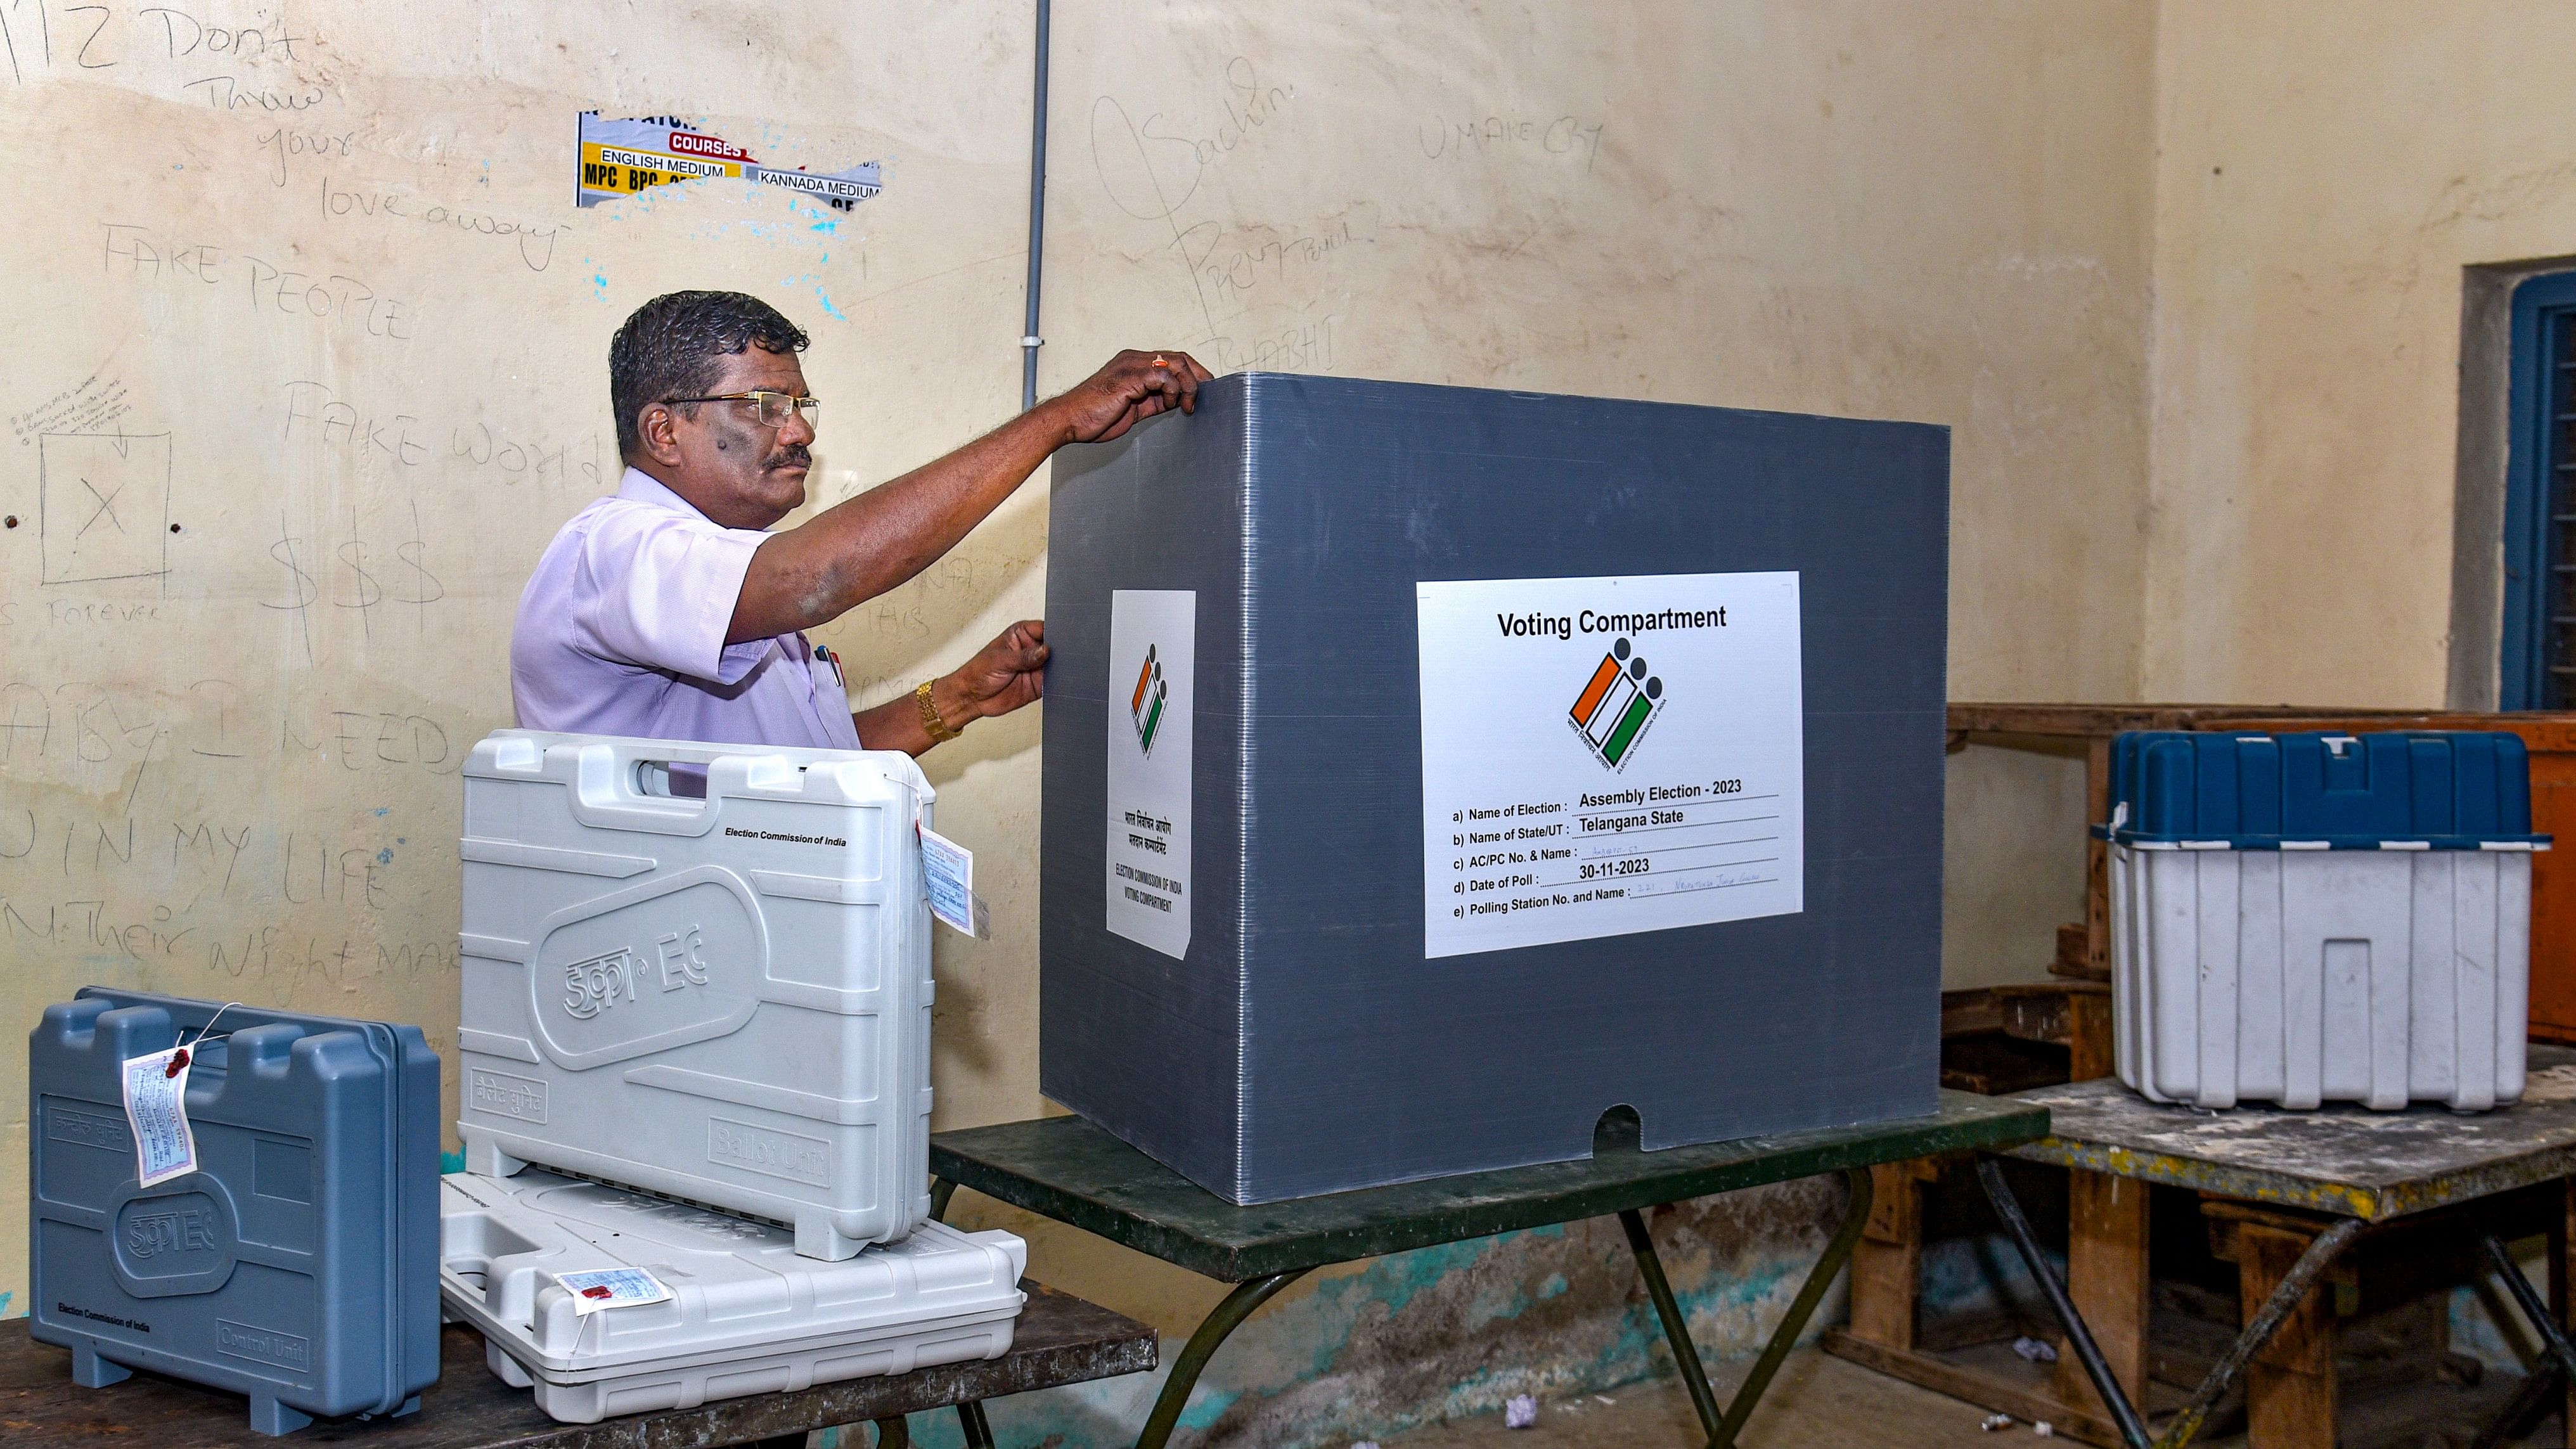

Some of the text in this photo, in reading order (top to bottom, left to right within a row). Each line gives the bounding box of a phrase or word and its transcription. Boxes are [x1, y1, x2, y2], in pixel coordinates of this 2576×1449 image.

[673, 134, 742, 158] COURSES
[585, 163, 617, 187] MPC
[602, 150, 723, 177] ENGLISH MEDIUM
[322, 176, 406, 221] love
[761, 172, 880, 198] KANNADA MEDIUM
[101, 223, 411, 340] FAKE PEOPLE
[283, 381, 428, 466] FAKE
[1497, 606, 1727, 640] Voting Compartment
[1617, 749, 1635, 775] ELECTION
[1632, 719, 1654, 750] COMMISSION
[1656, 699, 1668, 713] INDIA
[1453, 810, 1463, 823] a)
[1469, 808, 1500, 820] Name
[1504, 806, 1514, 817] of
[1517, 802, 1561, 815] Election
[1579, 789, 1645, 808] Assembly
[1649, 784, 1701, 801] Election
[1713, 778, 1742, 795] 2023
[725, 827, 847, 847] Election Commission of India
[1125, 809, 1171, 835] भारत निर्वाचन आयोग
[1453, 834, 1464, 847] b)
[1469, 831, 1500, 844] Name
[1504, 829, 1514, 840] of
[1518, 824, 1563, 840] State/UT
[1579, 815, 1647, 833] Telangana
[1651, 810, 1684, 825] State
[1129, 834, 1143, 849] मतदान
[1453, 858, 1464, 872] c)
[1469, 853, 1505, 868] AC/PC
[1509, 853, 1526, 864] No.
[1530, 850, 1538, 861] &
[1542, 848, 1571, 860] Name
[1116, 863, 1183, 896] ELECTION COMMISSION OF INDIA
[1453, 881, 1465, 895] d)
[1470, 879, 1495, 892] Date
[1498, 877, 1509, 888] of
[1512, 874, 1532, 887] Poll
[1579, 858, 1649, 880] 30-11-2023
[1124, 886, 1172, 913] VOTING COMPARTMENT
[1453, 905, 1464, 919] e)
[1470, 901, 1508, 915] Polling
[1511, 897, 1549, 911] Station
[1552, 894, 1569, 905] No.
[1573, 891, 1592, 903] and
[1595, 887, 1625, 901] Name
[716, 1127, 824, 1177] Ballot Unit
[58, 1302, 150, 1333] Election Commission of India
[220, 1327, 304, 1363] Control Unit
